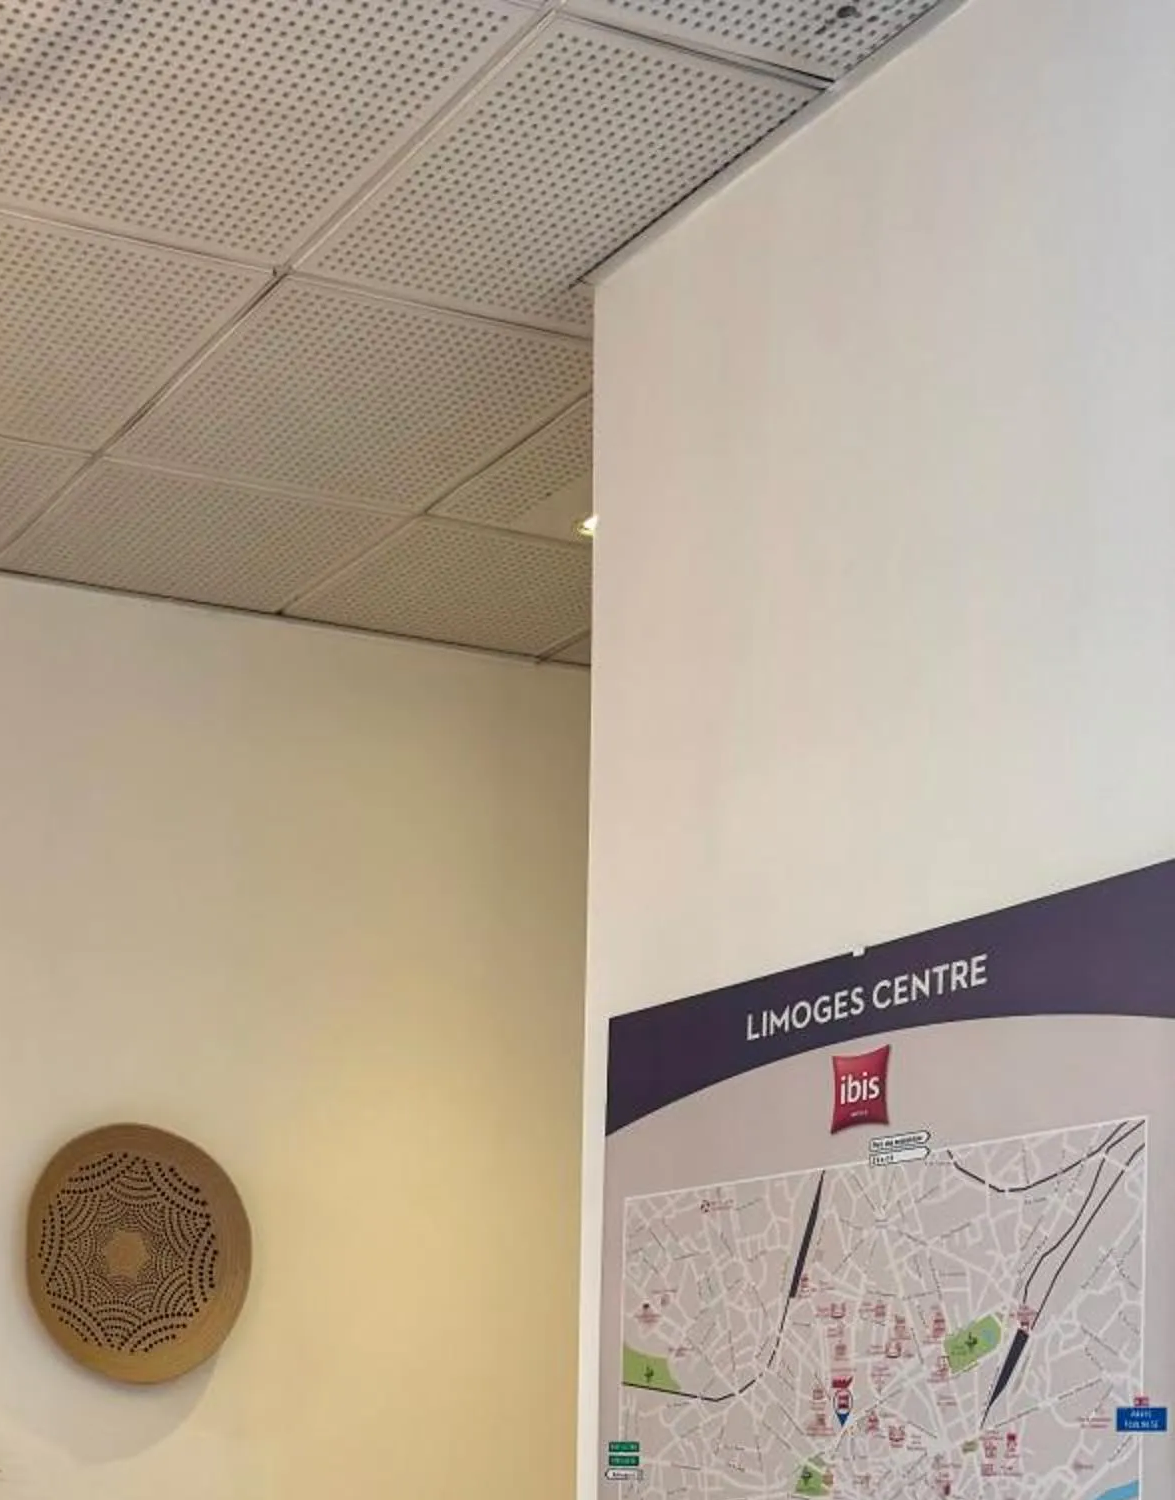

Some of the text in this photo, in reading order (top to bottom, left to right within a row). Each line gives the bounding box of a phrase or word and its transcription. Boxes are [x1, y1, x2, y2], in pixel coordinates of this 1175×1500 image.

[746, 953, 988, 1041] LIMOGES CENTRE
[840, 1071, 881, 1105] ibis
